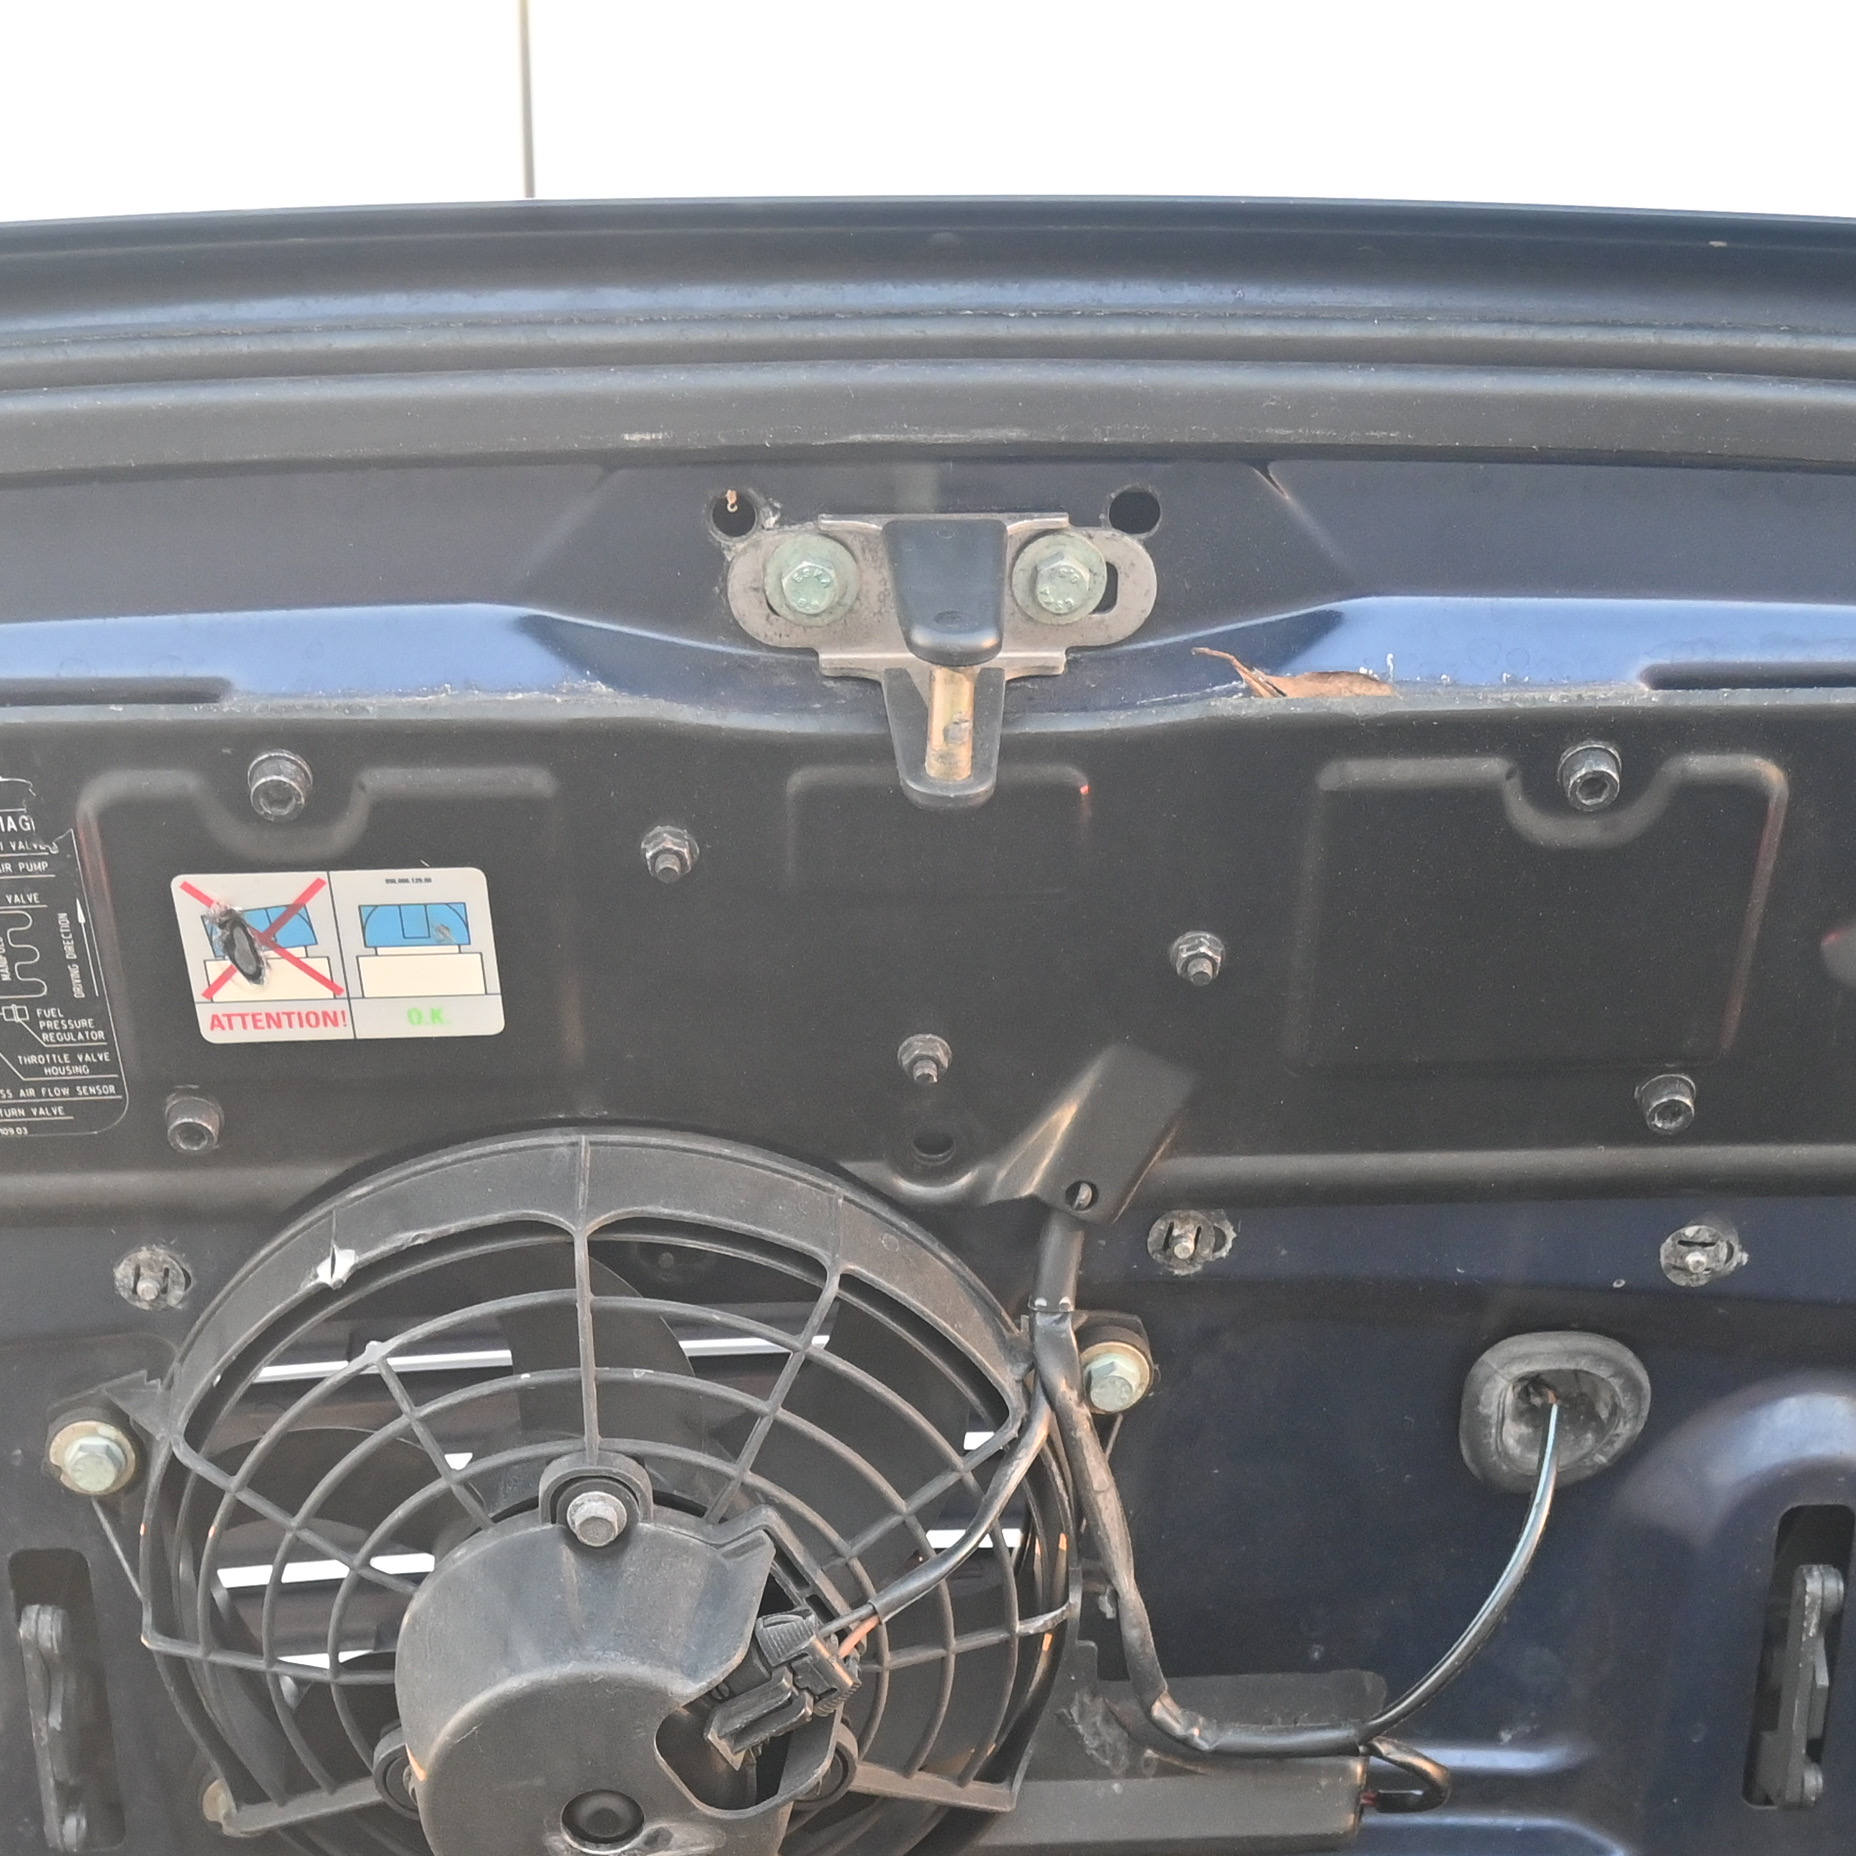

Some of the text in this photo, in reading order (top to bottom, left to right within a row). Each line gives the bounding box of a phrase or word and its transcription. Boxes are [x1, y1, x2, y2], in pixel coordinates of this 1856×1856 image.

[18, 861, 48, 872] PUMP
[6, 893, 40, 904] VALVE
[57, 912, 84, 998] DRIVING DIRECTION
[36, 1007, 63, 1018] FUEL
[39, 1018, 94, 1029] PRESSURE
[209, 1009, 348, 1032] ATTENTION!
[42, 1030, 105, 1042] REGULATOR
[17, 1052, 110, 1064] THROTTLE VALVE
[44, 1064, 89, 1075] HOUSING
[19, 1087, 35, 1098] AIR
[41, 1086, 69, 1097] FLOW
[76, 1084, 116, 1095] SENSOR
[31, 1106, 65, 1117] VALVE
